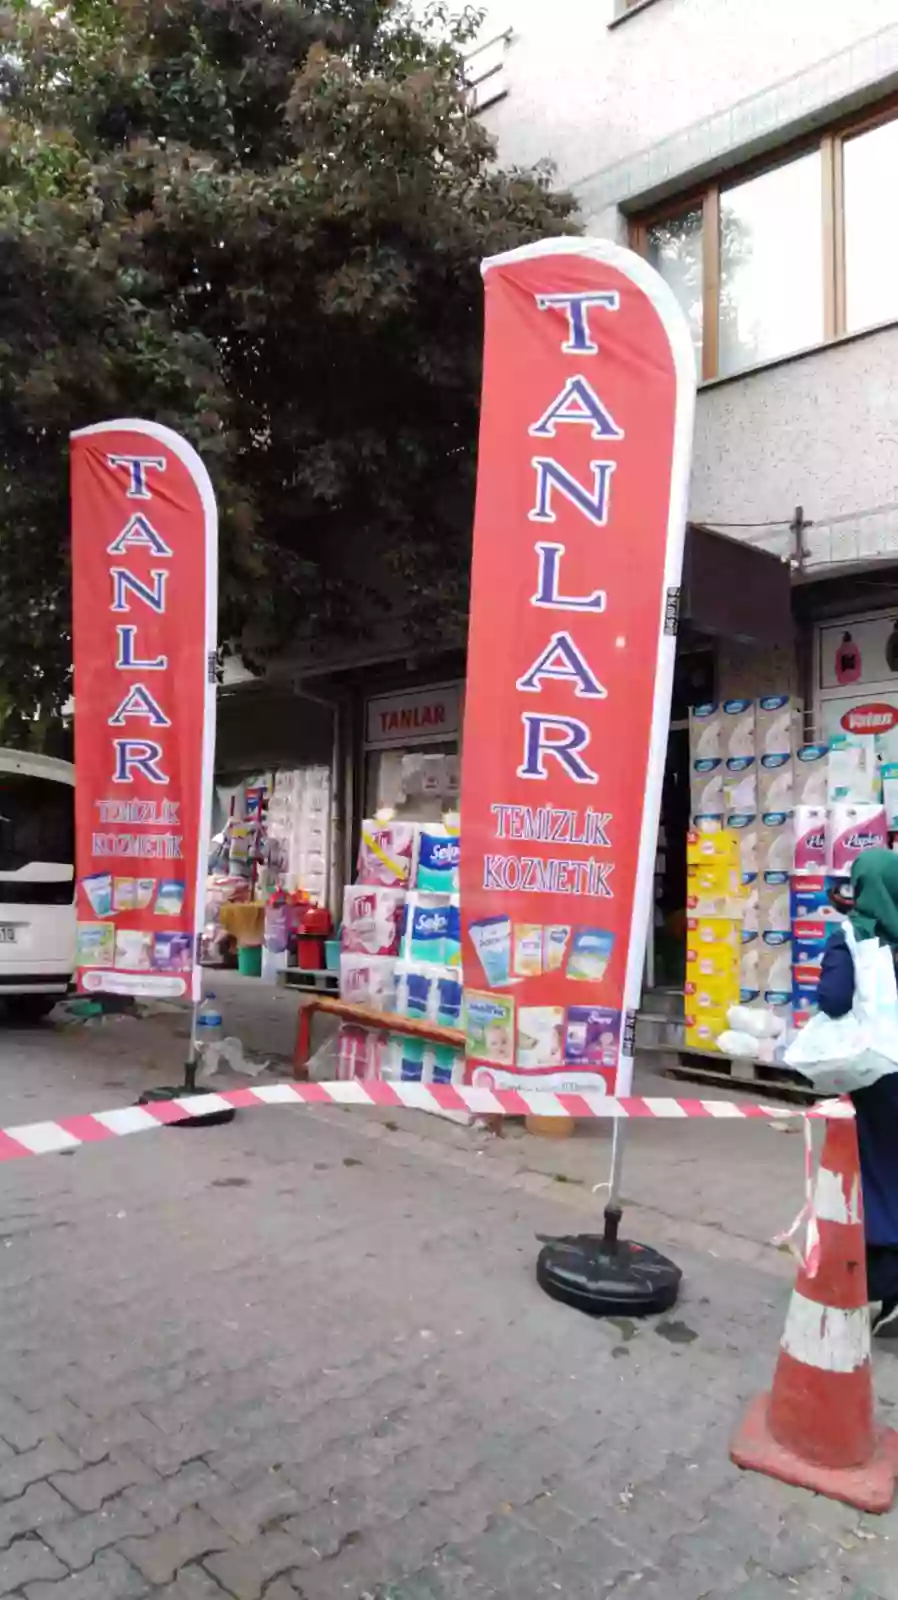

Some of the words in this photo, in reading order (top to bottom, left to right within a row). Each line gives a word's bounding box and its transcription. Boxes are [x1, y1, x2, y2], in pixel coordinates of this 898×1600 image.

[516, 290, 624, 783] TANLAR
[107, 454, 173, 785] TANLAR
[379, 702, 445, 732] TANLAR
[490, 803, 613, 848] TEMİZLİK
[483, 854, 615, 897] KOZMETİK
